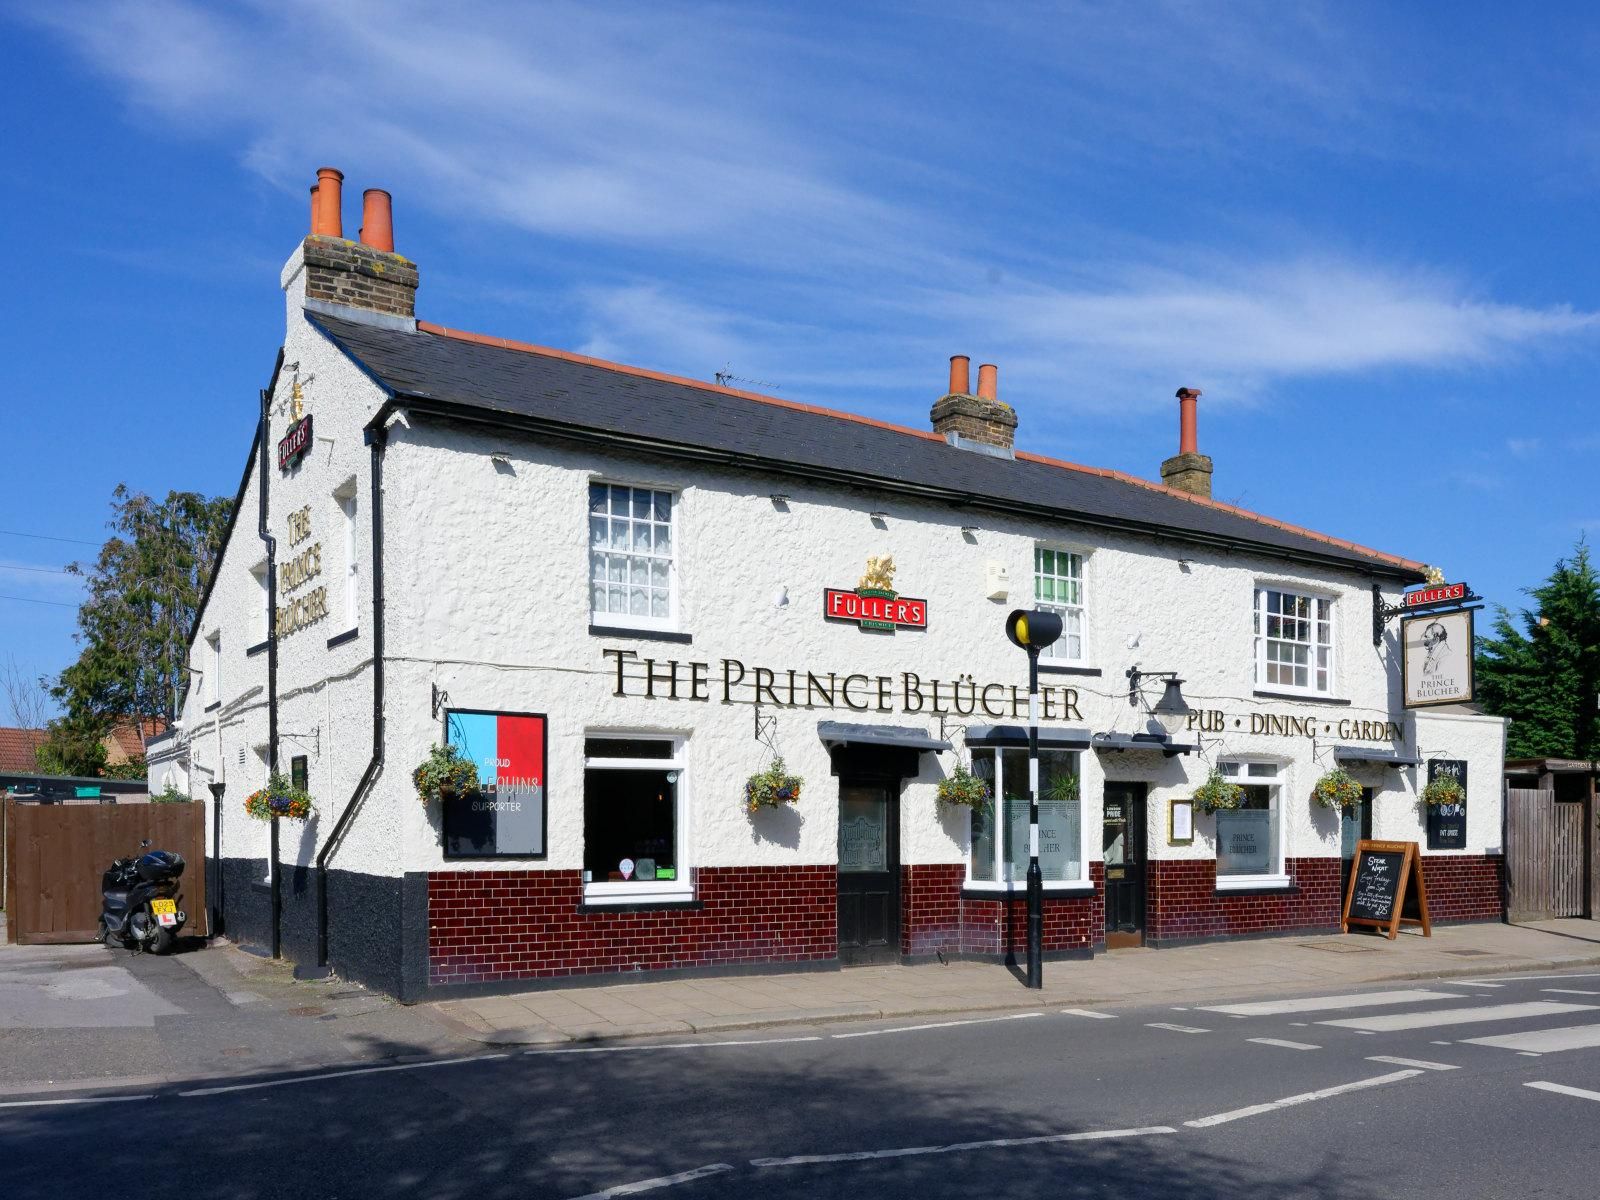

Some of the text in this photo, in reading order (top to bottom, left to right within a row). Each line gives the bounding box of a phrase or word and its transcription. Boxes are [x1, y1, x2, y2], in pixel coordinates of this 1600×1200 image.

[287, 505, 311, 547] THE
[833, 594, 921, 622] FULLER'S
[602, 648, 709, 702] THE
[720, 658, 893, 713] PRINCE
[1421, 678, 1455, 688] PRINCE
[1186, 708, 1404, 742] PUB DINING GARDEN
[484, 758, 510, 767] PROUD
[480, 776, 539, 795] LEQUINS
[472, 801, 521, 811] SUPPORTER
[1232, 833, 1255, 842] PRINCE
[162, 914, 172, 922] L
